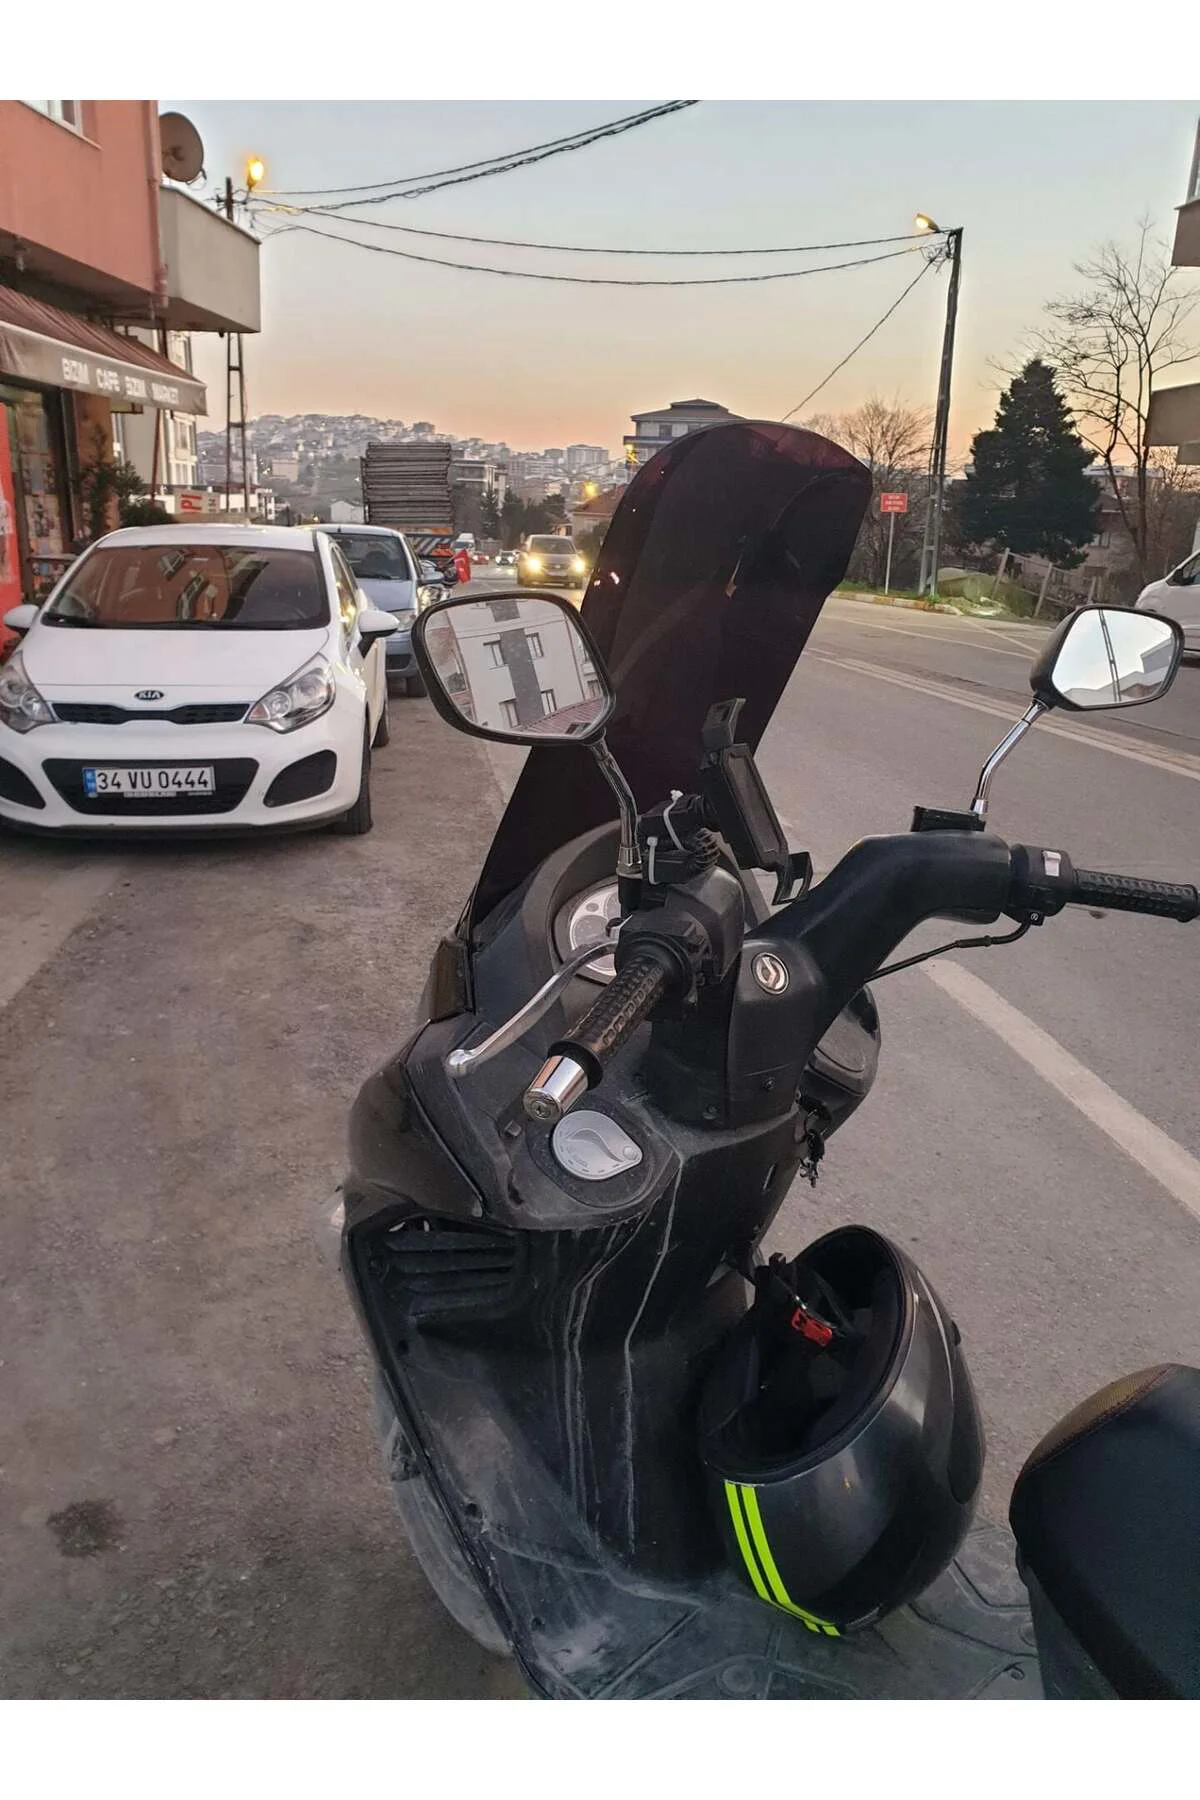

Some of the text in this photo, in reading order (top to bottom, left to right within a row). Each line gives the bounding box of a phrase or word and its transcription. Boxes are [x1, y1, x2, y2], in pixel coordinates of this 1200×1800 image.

[96, 368, 121, 392] CAFE
[138, 690, 161, 700] KIA
[97, 770, 209, 790] 34 VU 0444
